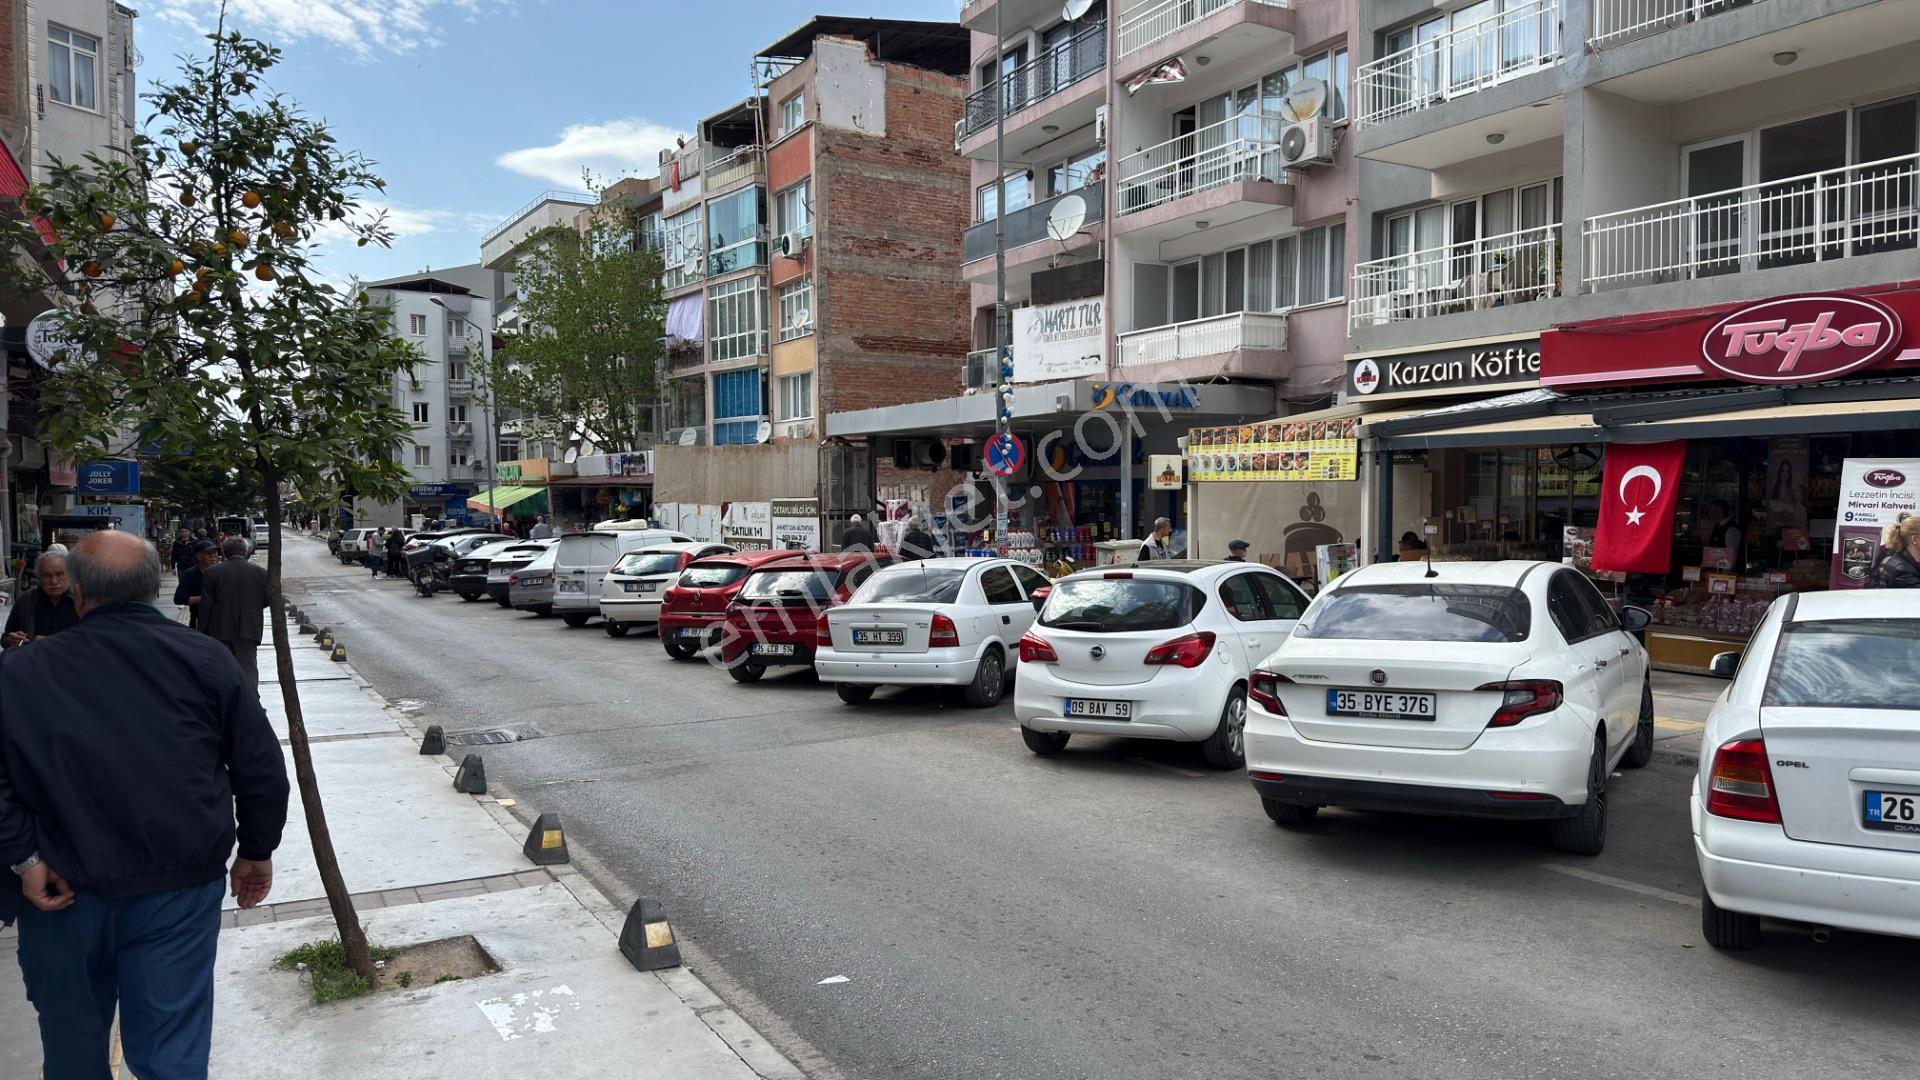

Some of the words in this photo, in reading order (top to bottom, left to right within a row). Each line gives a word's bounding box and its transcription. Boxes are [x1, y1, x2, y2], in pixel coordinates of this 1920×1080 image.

[1078, 302, 1102, 329] TUR
[1388, 361, 1464, 386] Kazan
[1471, 348, 1541, 378] Köfte
[88, 477, 113, 485] JOKER
[1849, 490, 1888, 499] Lezzetin
[1848, 501, 1880, 509] Mirvari
[1881, 502, 1916, 510] Kahvesi
[1844, 511, 1854, 522] 9
[731, 526, 753, 537] SATILIK
[754, 527, 763, 537] 1+1
[859, 631, 868, 641] 35
[887, 632, 901, 642] 399
[1071, 701, 1084, 713] 09
[1089, 702, 1108, 715] BAV
[1115, 703, 1128, 716] 59
[1338, 693, 1356, 710] 35
[1364, 694, 1393, 712] BYE
[1399, 696, 1429, 714] 376
[1776, 760, 1810, 769] OPEL
[1868, 808, 1880, 816] TR
[1883, 796, 1914, 821] 26
